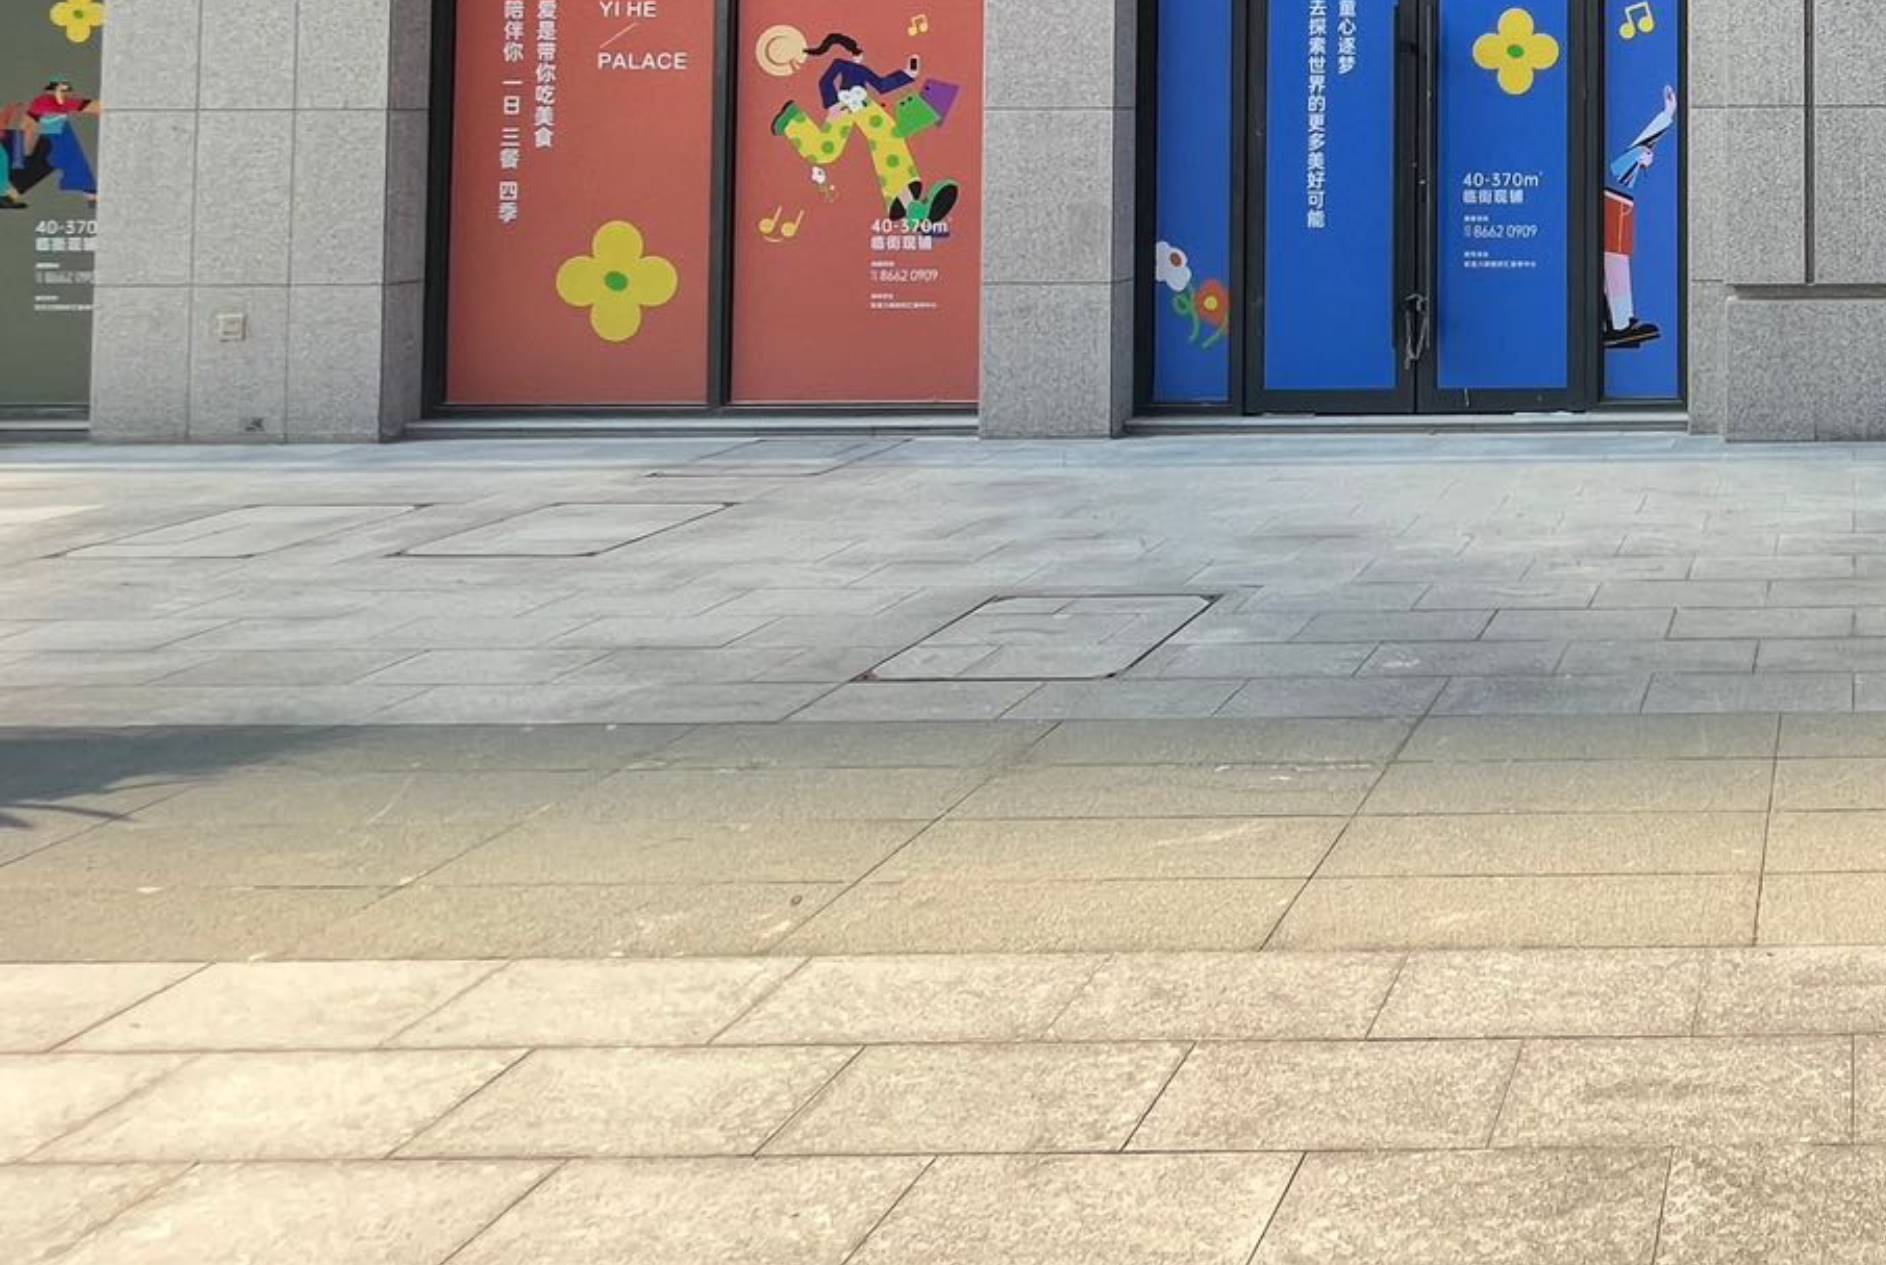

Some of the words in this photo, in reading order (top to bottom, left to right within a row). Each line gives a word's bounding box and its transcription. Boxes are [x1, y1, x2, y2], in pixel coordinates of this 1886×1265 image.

[599, 0, 620, 18] YI
[626, 0, 657, 18] HE
[598, 52, 688, 71] PALACE
